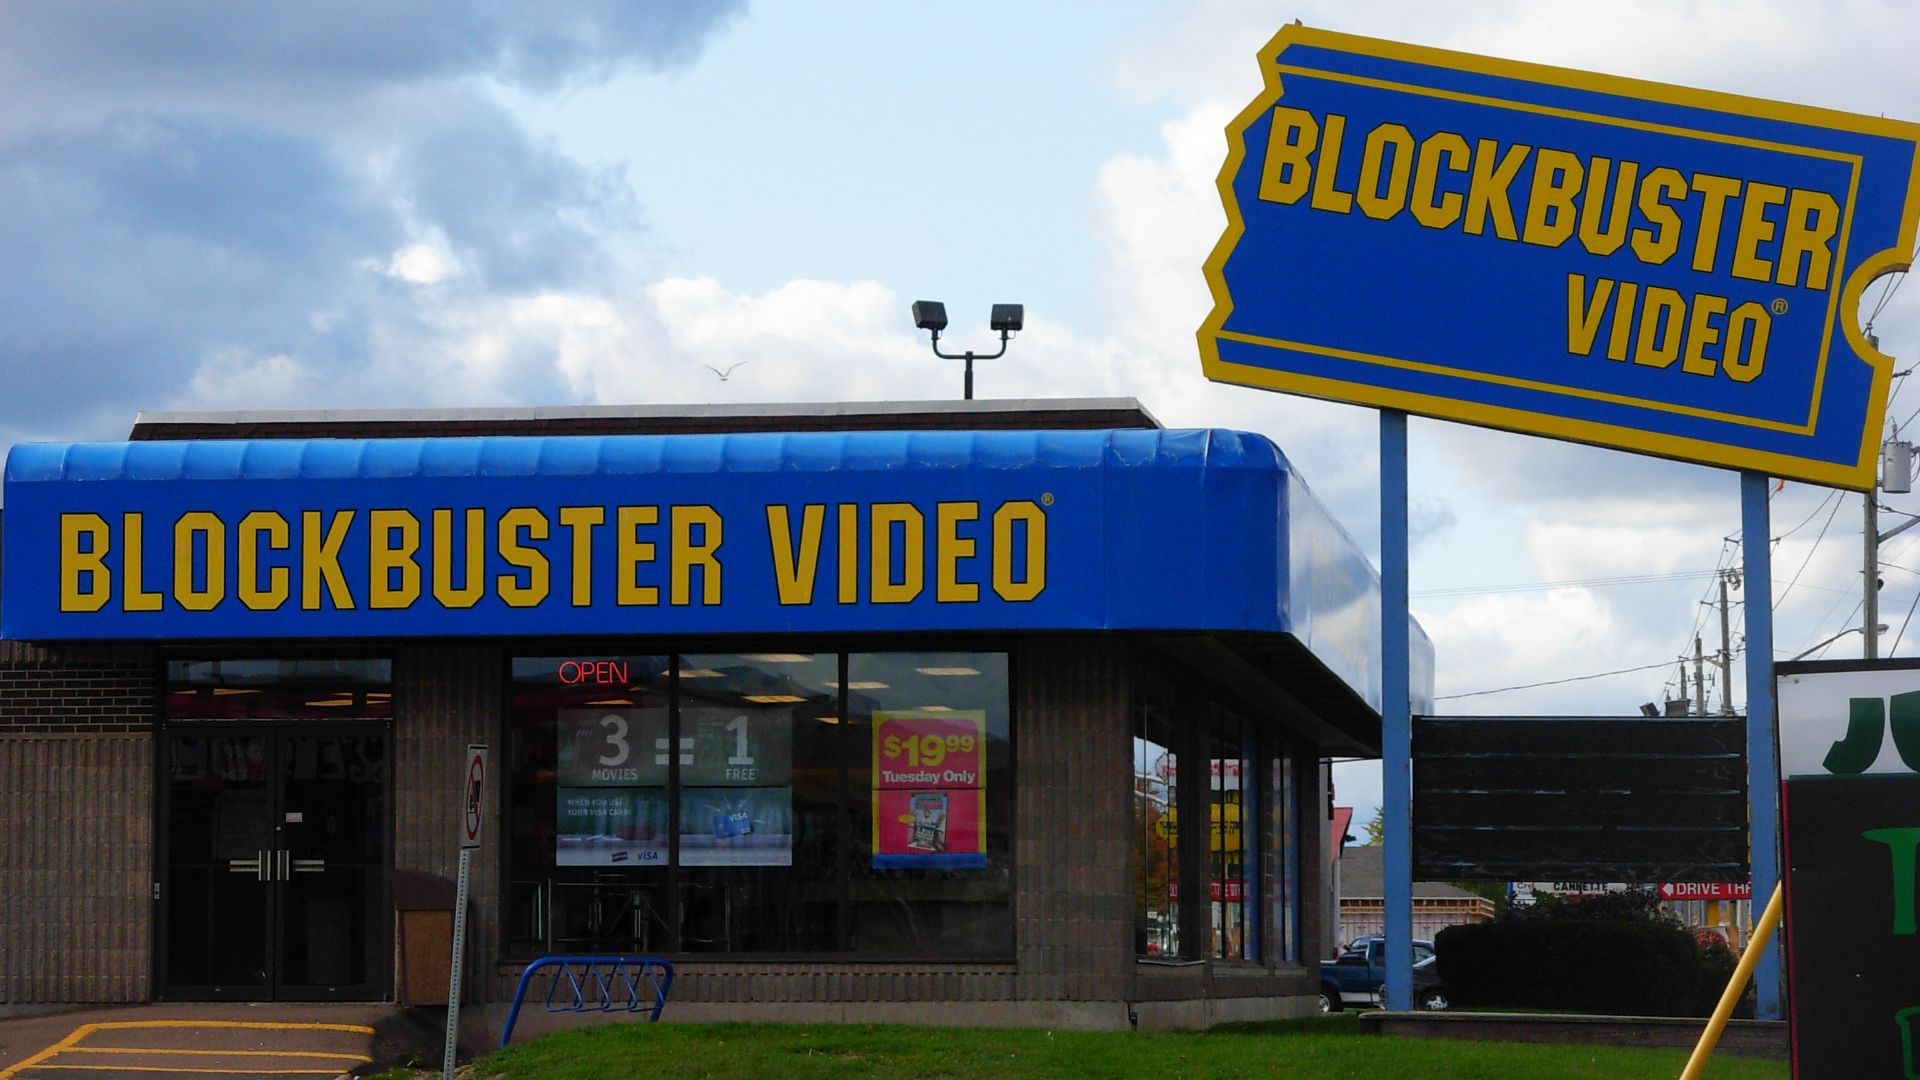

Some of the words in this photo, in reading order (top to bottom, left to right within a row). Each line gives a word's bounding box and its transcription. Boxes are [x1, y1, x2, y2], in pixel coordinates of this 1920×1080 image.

[1258, 105, 1841, 291] BLOCKBUSTER
[59, 503, 723, 613] BLOCKBUSTER
[558, 660, 628, 684] OPEN
[598, 714, 631, 767] 3
[725, 715, 755, 765] 1
[592, 768, 639, 781] MOVIES
[883, 770, 940, 784] Tuesday
[943, 769, 976, 784] Only
[638, 851, 659, 861] VISA
[1676, 882, 1721, 896] DRIVE
